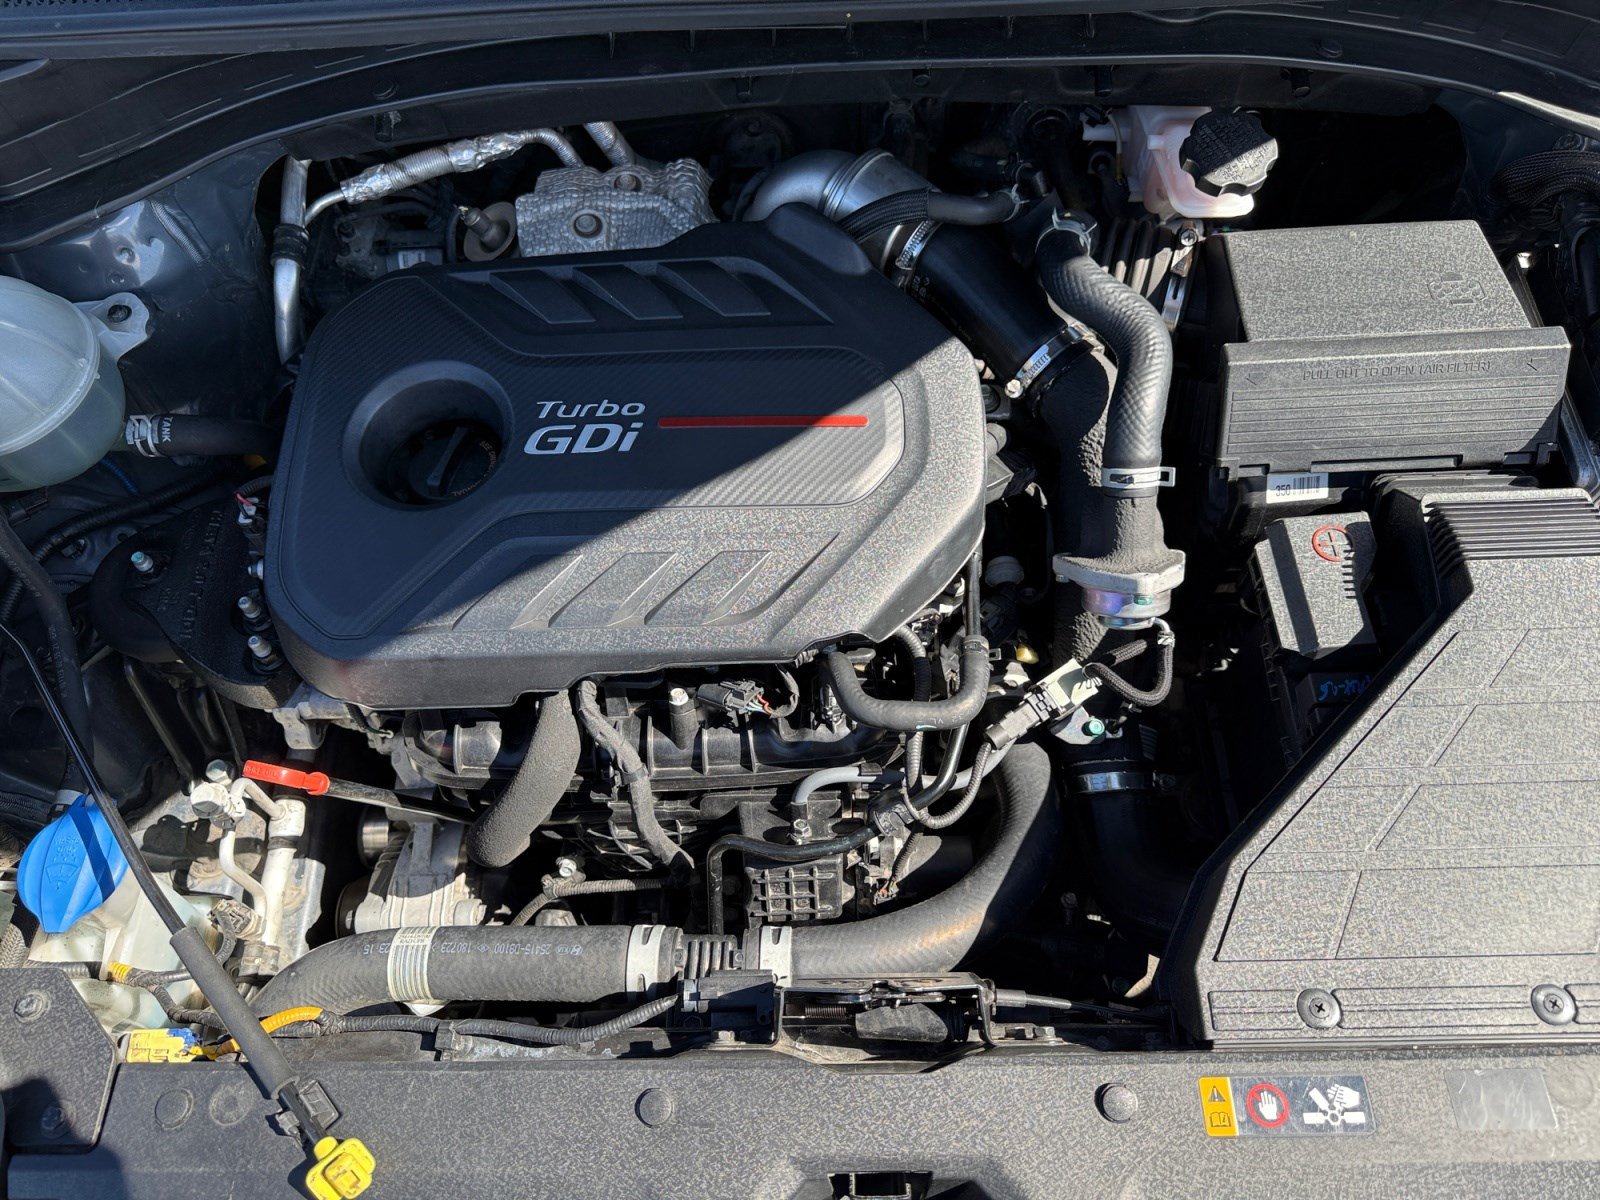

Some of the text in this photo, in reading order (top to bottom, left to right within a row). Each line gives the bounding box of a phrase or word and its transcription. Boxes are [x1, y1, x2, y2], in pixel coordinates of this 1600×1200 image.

[1302, 360, 1492, 381] PULL OUT TO OPEN (AIR FILTER)
[536, 399, 646, 419] Turbo
[161, 416, 174, 443] TANK
[523, 422, 644, 455] GDi
[1275, 484, 1291, 497] 350
[440, 942, 473, 954] 180723
